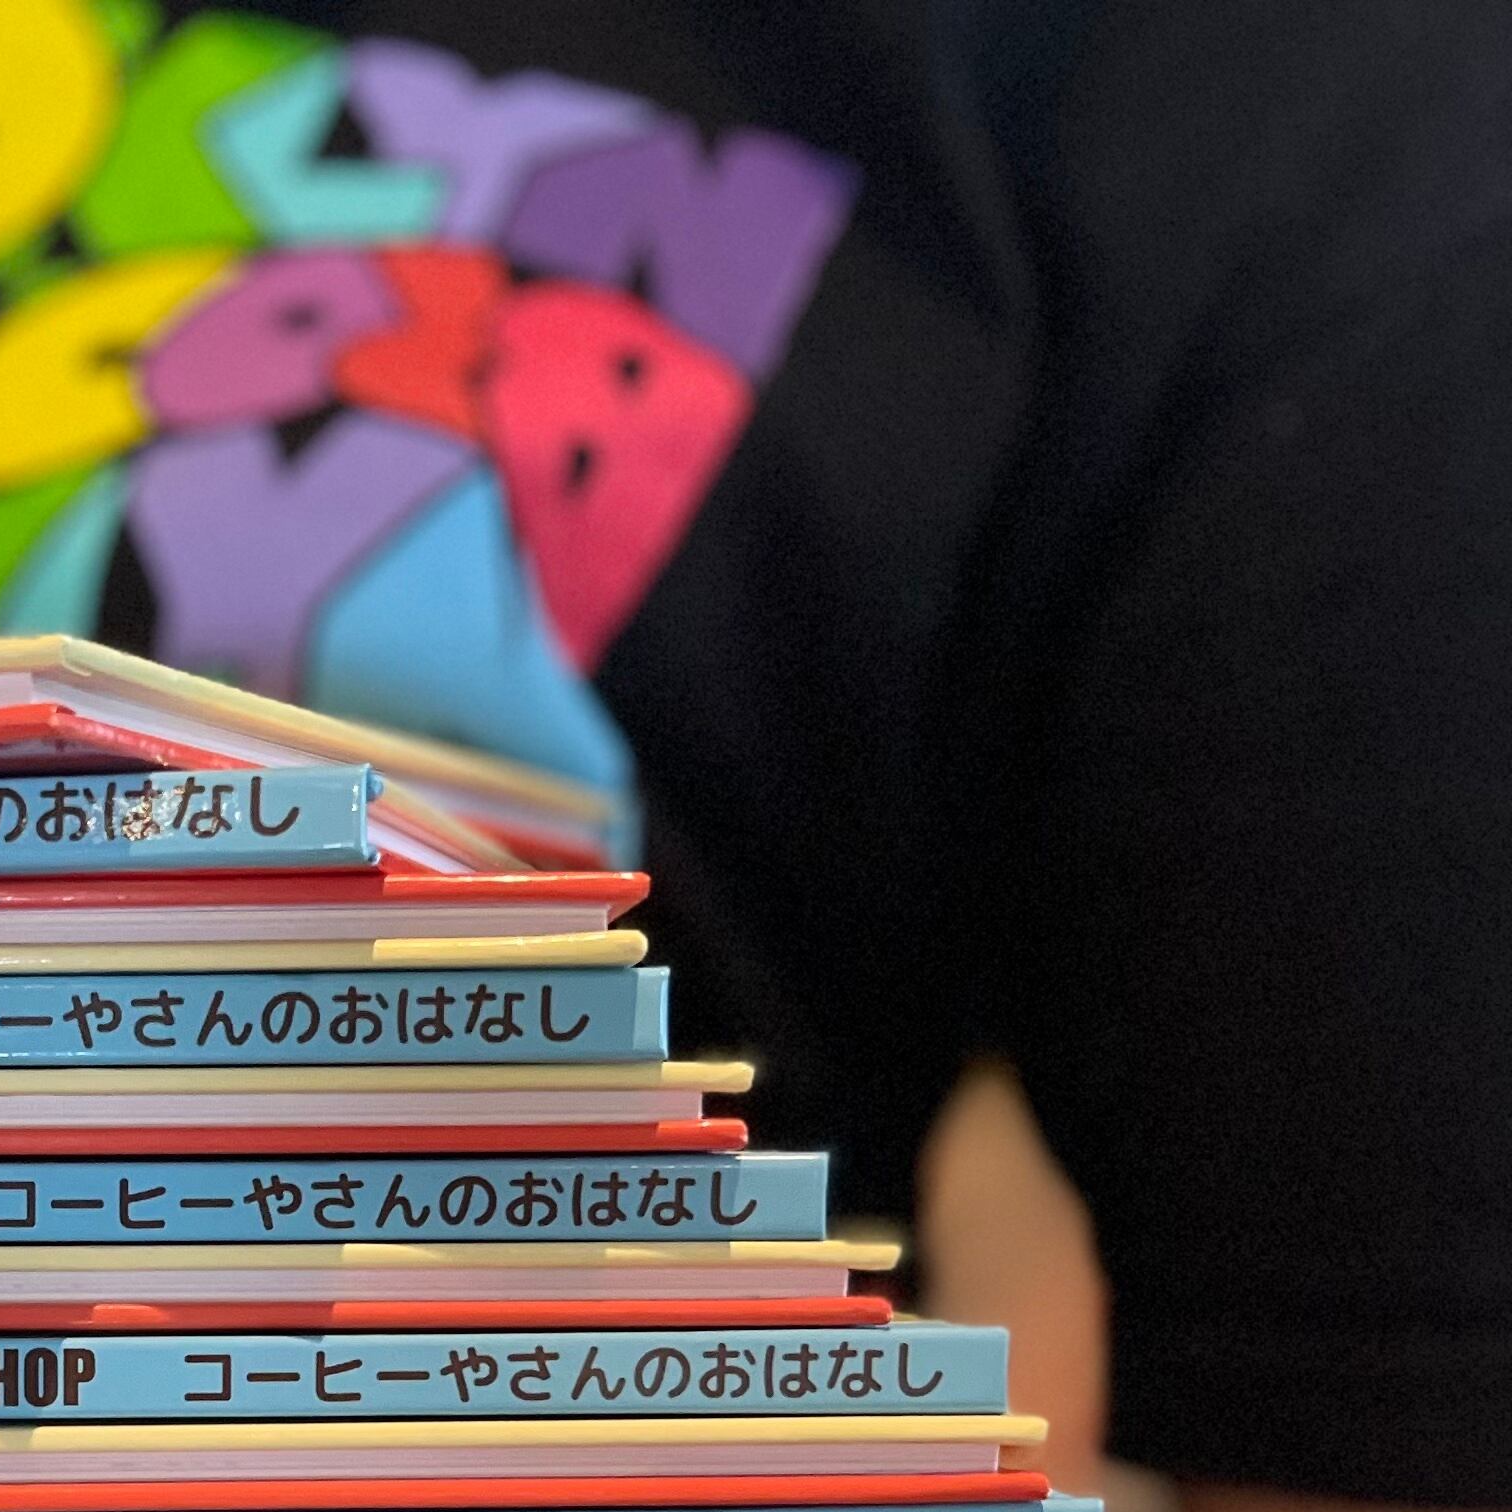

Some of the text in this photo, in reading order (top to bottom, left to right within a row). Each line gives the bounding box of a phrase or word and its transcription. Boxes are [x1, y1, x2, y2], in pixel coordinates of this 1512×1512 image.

[185, 1341, 944, 1403] コーヒーやさんのおはなし
